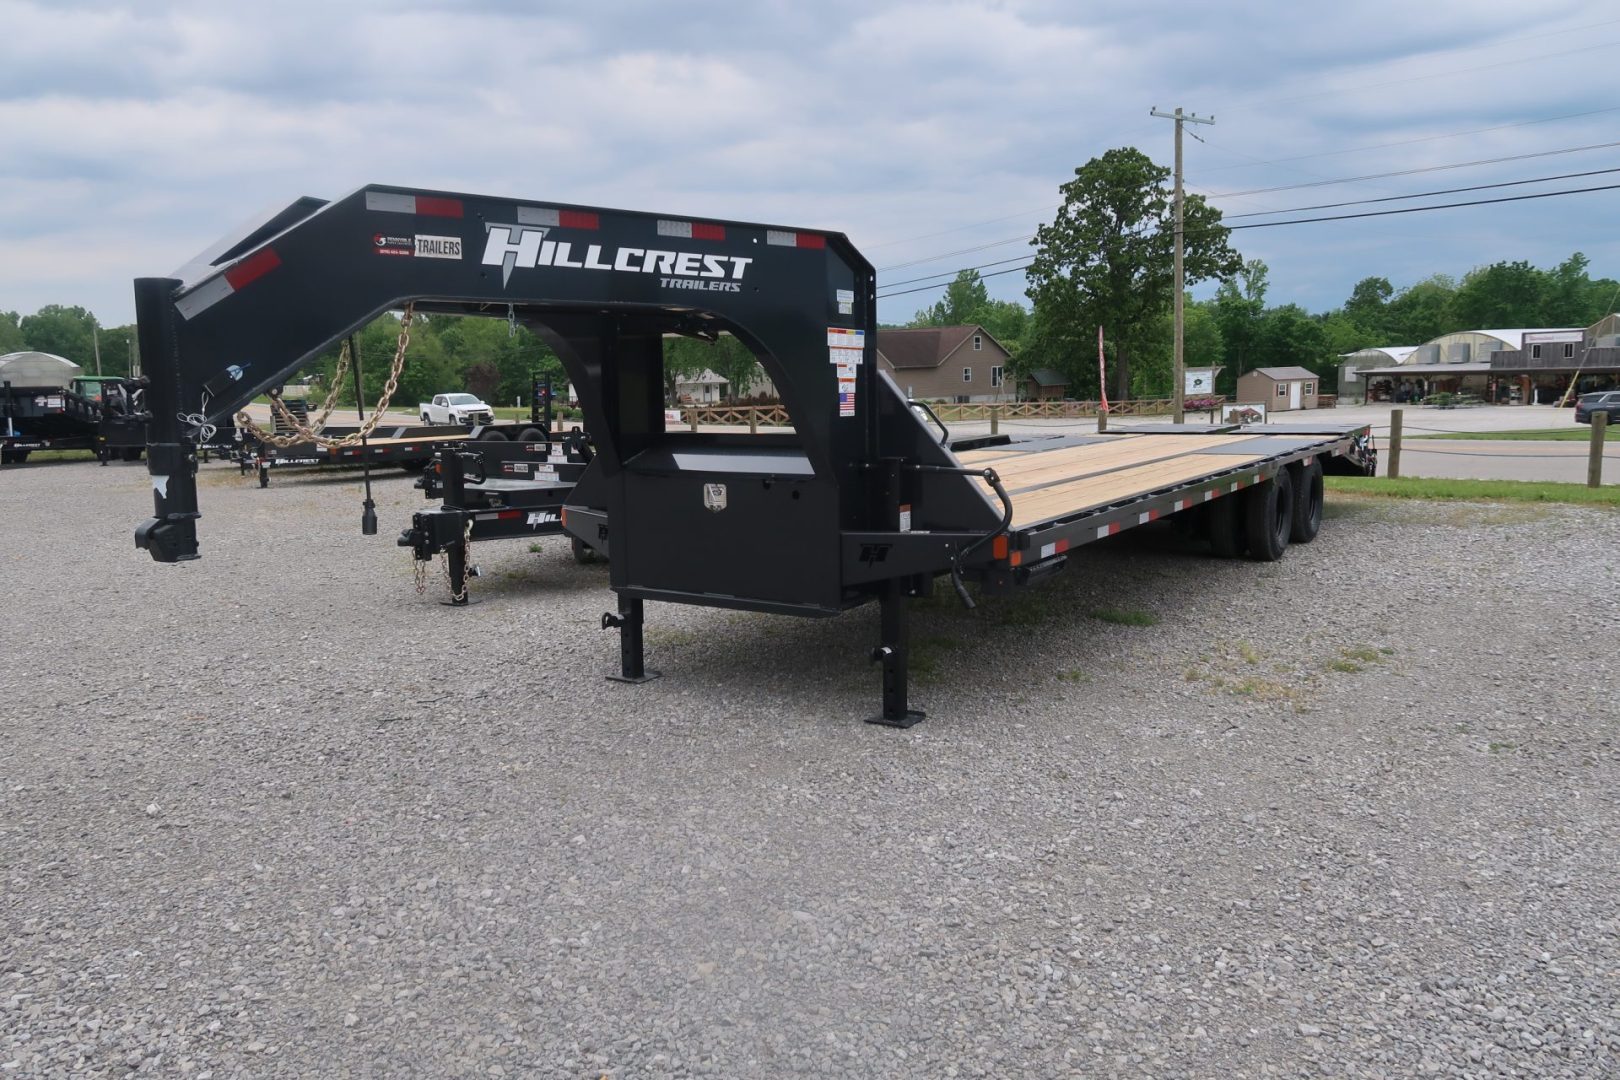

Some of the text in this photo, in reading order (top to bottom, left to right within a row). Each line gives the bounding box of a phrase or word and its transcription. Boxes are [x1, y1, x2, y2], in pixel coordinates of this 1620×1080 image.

[417, 239, 460, 255] TRAILERS
[482, 223, 753, 284] HILLCREST
[660, 277, 742, 292] TRAILERS
